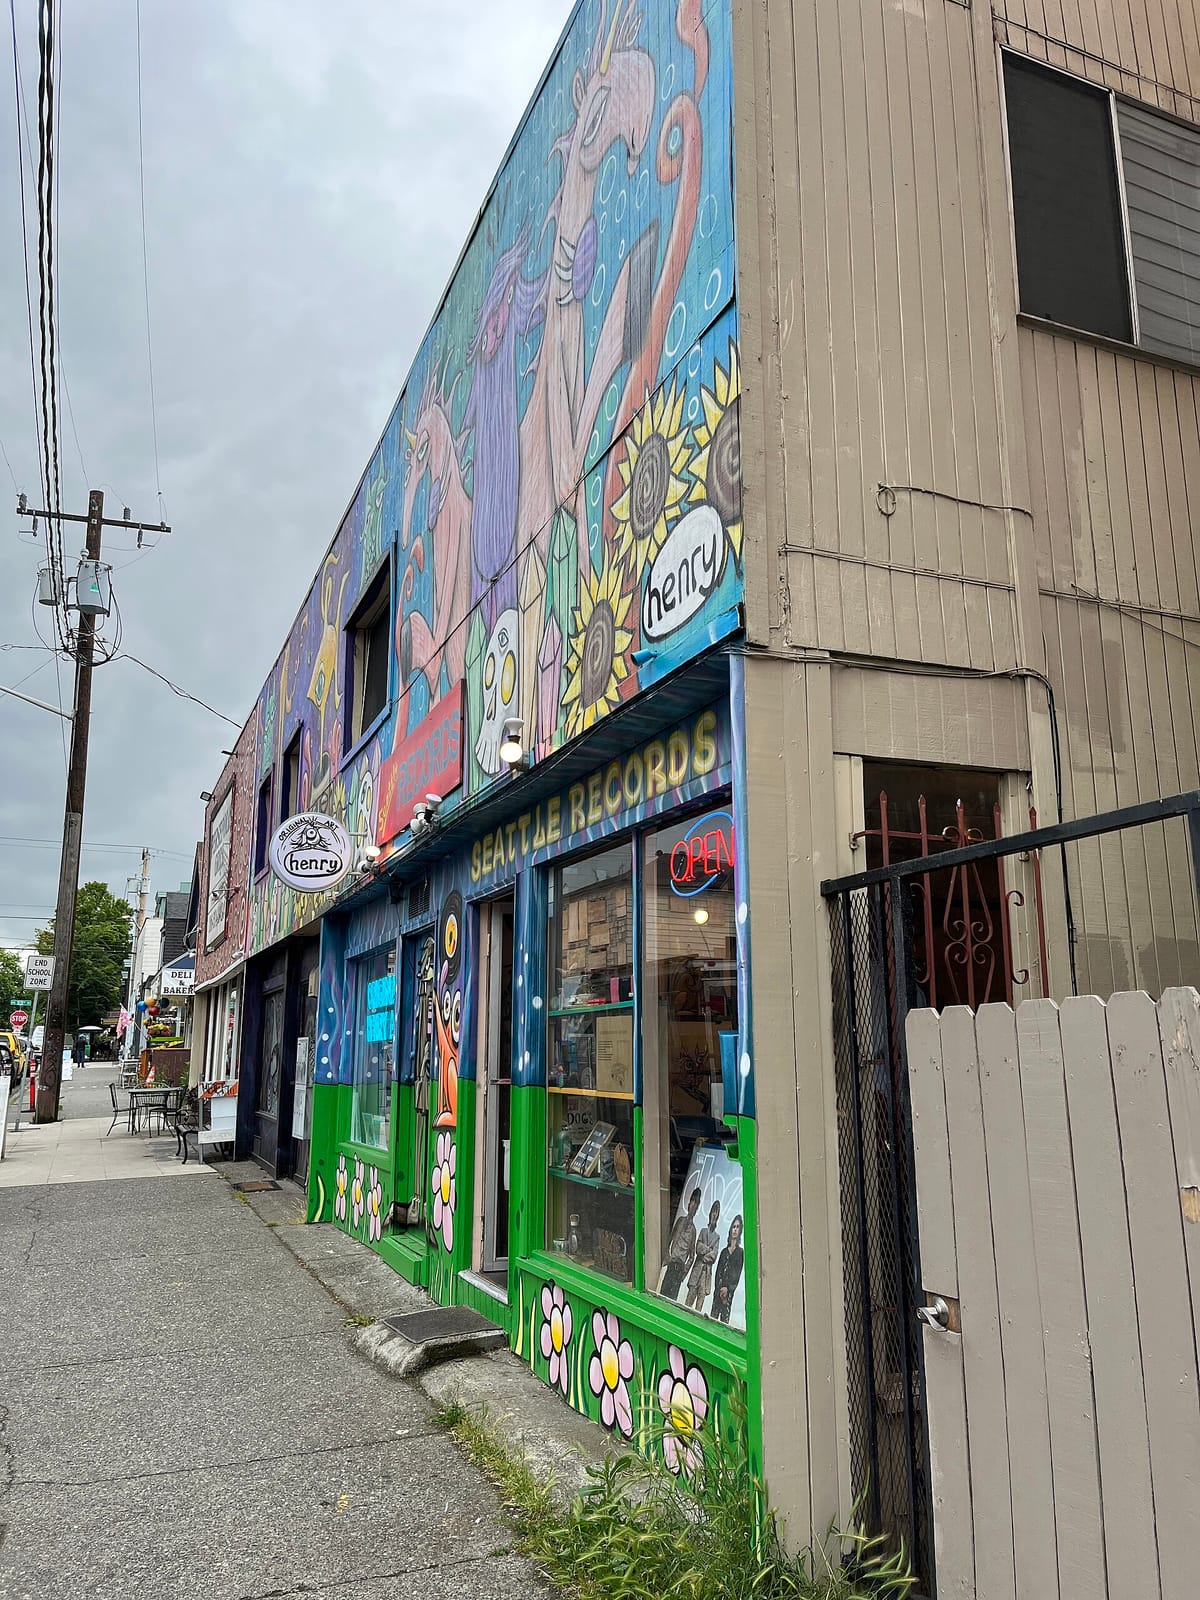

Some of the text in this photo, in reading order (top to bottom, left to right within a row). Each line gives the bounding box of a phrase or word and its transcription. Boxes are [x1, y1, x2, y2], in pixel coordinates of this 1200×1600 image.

[647, 533, 717, 629] henry
[397, 708, 460, 812] RECORDS
[471, 796, 561, 882] SEATTLE
[568, 710, 717, 833] RECORDS
[278, 816, 339, 841] ORIGINAL ART
[289, 853, 338, 873] henry
[670, 826, 735, 882] OPEN
[28, 968, 51, 977] SCHOOL
[171, 971, 192, 979] DELI
[163, 986, 194, 994] BAKER
